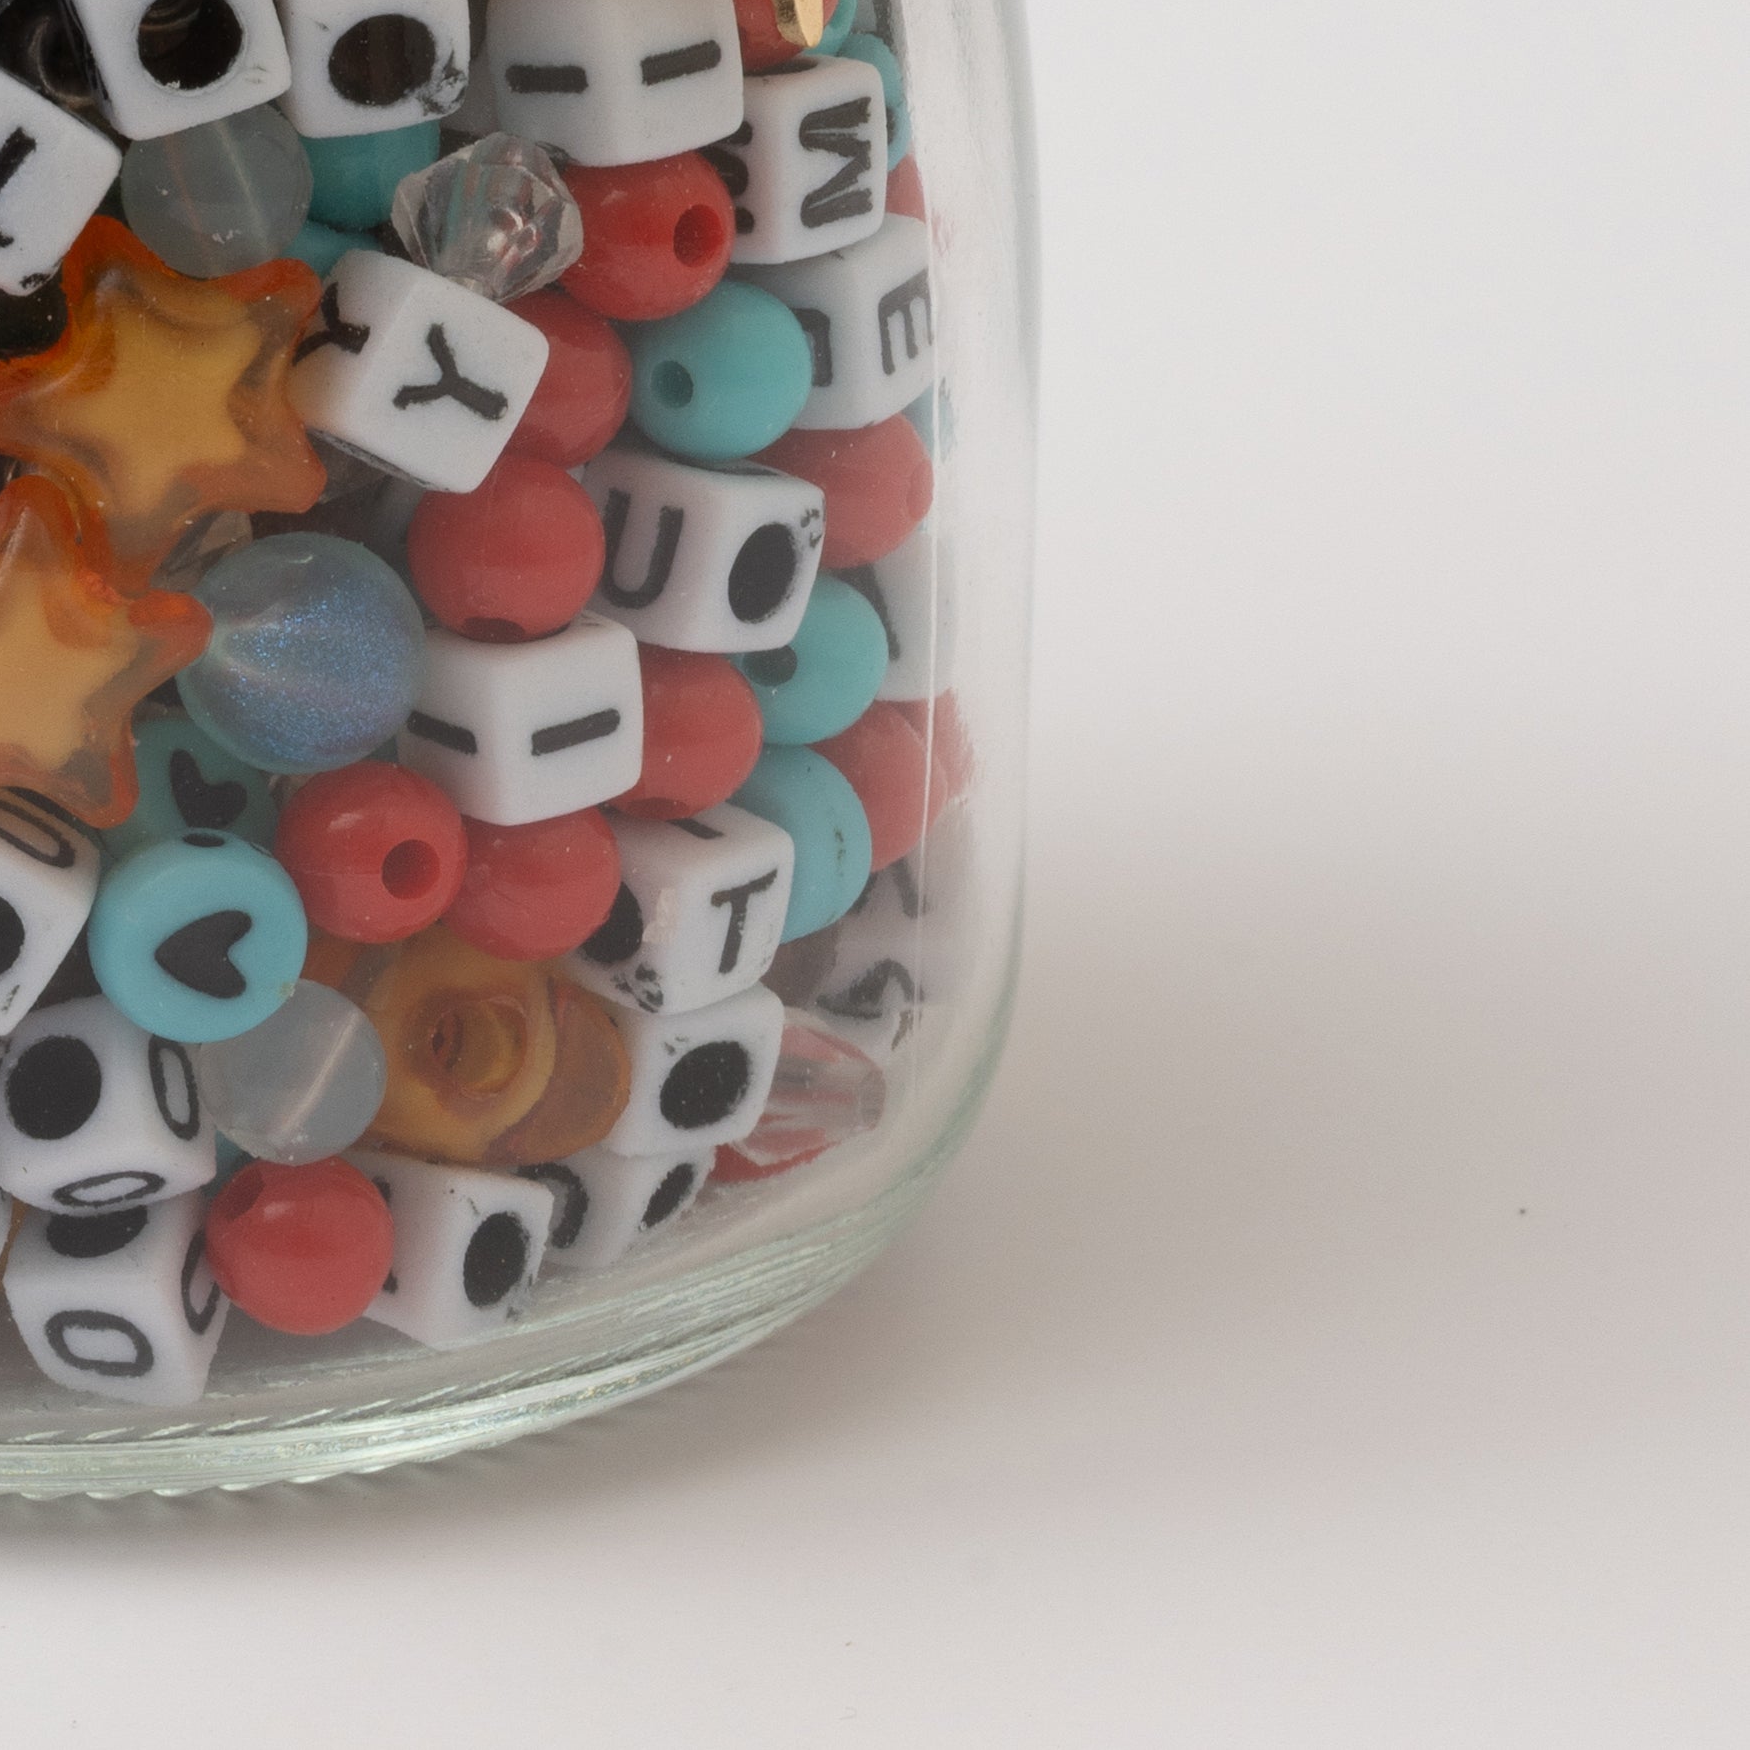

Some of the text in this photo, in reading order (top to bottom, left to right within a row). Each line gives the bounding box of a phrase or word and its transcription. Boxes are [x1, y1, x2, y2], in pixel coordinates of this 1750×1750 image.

[391, 320, 511, 422] Y
[602, 486, 685, 610] U
[710, 868, 779, 976] T
